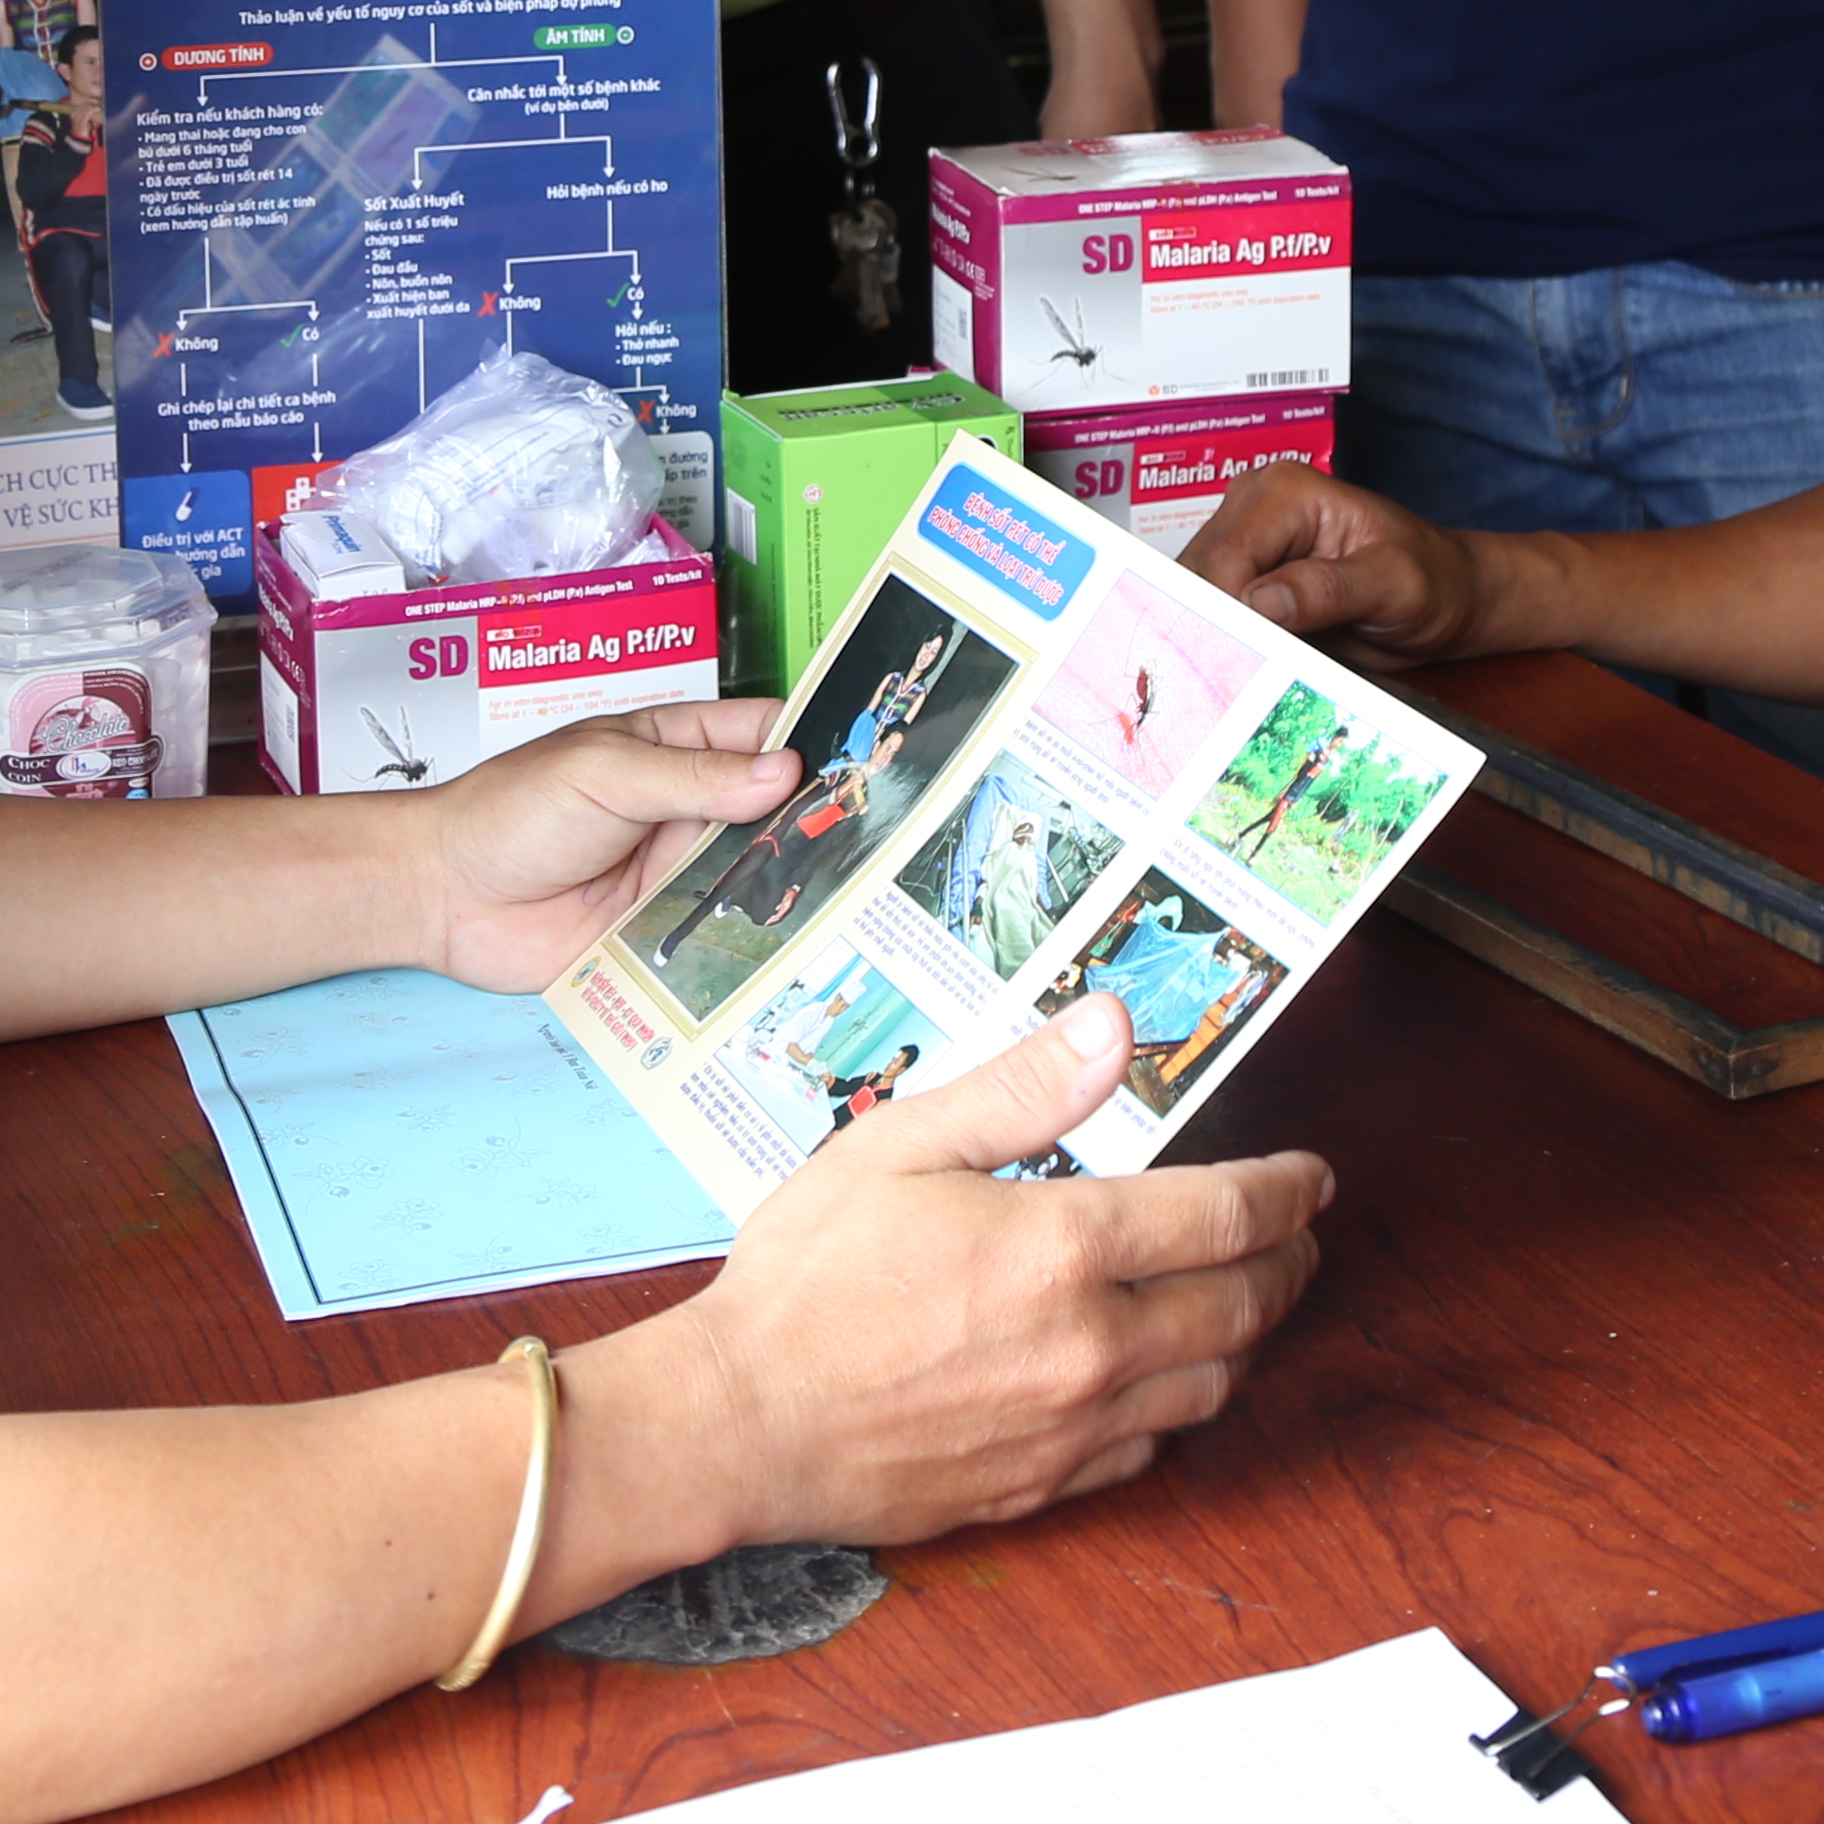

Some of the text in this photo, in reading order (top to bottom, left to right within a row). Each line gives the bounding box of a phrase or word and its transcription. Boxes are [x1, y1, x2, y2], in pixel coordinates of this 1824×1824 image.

[238, 9, 273, 25] Thảo
[274, 8, 305, 26] luận
[306, 5, 324, 22] về
[326, 4, 352, 24] yếu
[354, 3, 371, 20] tố
[371, 6, 406, 21] nguy
[407, 5, 425, 17] cơ
[425, 0, 450, 16] của
[546, 26, 605, 45] ÂM TÍNH
[174, 46, 265, 66] DƯƠNG TÍNH
[467, 77, 661, 103] Căn nhắc tới một số bệnh khác
[136, 103, 324, 126] Kiểm tra nếu khách hàng có:
[363, 192, 465, 212] Sốt Xuất Huyết
[1082, 232, 1135, 275] SD
[1150, 232, 1331, 268] Malaria Ag P.f/P.v
[499, 295, 542, 311] Không
[175, 336, 219, 352] Không
[302, 326, 320, 341] Có
[157, 390, 337, 417] Ghi chép lại chi tiết ca bệnh
[656, 403, 697, 419] Không
[29, 465, 79, 493] CỰC
[83, 461, 118, 483] TH
[1073, 458, 1126, 500] SD
[1138, 463, 1216, 491] Malaria
[2, 502, 32, 532] VỆ
[38, 498, 83, 524] SỨC
[89, 495, 119, 520] KH
[141, 527, 244, 549] Điều trị với ACT
[927, 505, 962, 538] PHÒNG
[956, 524, 990, 557] CHỐNG
[984, 542, 1004, 566] VÀ
[996, 551, 1023, 579] LOẠI
[963, 492, 1067, 566] BỆNH SỐT RÉT CÓ THỂ
[652, 575, 665, 586] 10
[405, 605, 423, 617] ONE
[424, 603, 446, 614] STEP
[446, 600, 478, 612] Malaria
[585, 584, 616, 597] Antigen
[616, 580, 633, 592] Test
[408, 634, 469, 680] SD
[487, 623, 695, 672] Malaria Ag P.f/P.v
[39, 713, 129, 753] Chocolate
